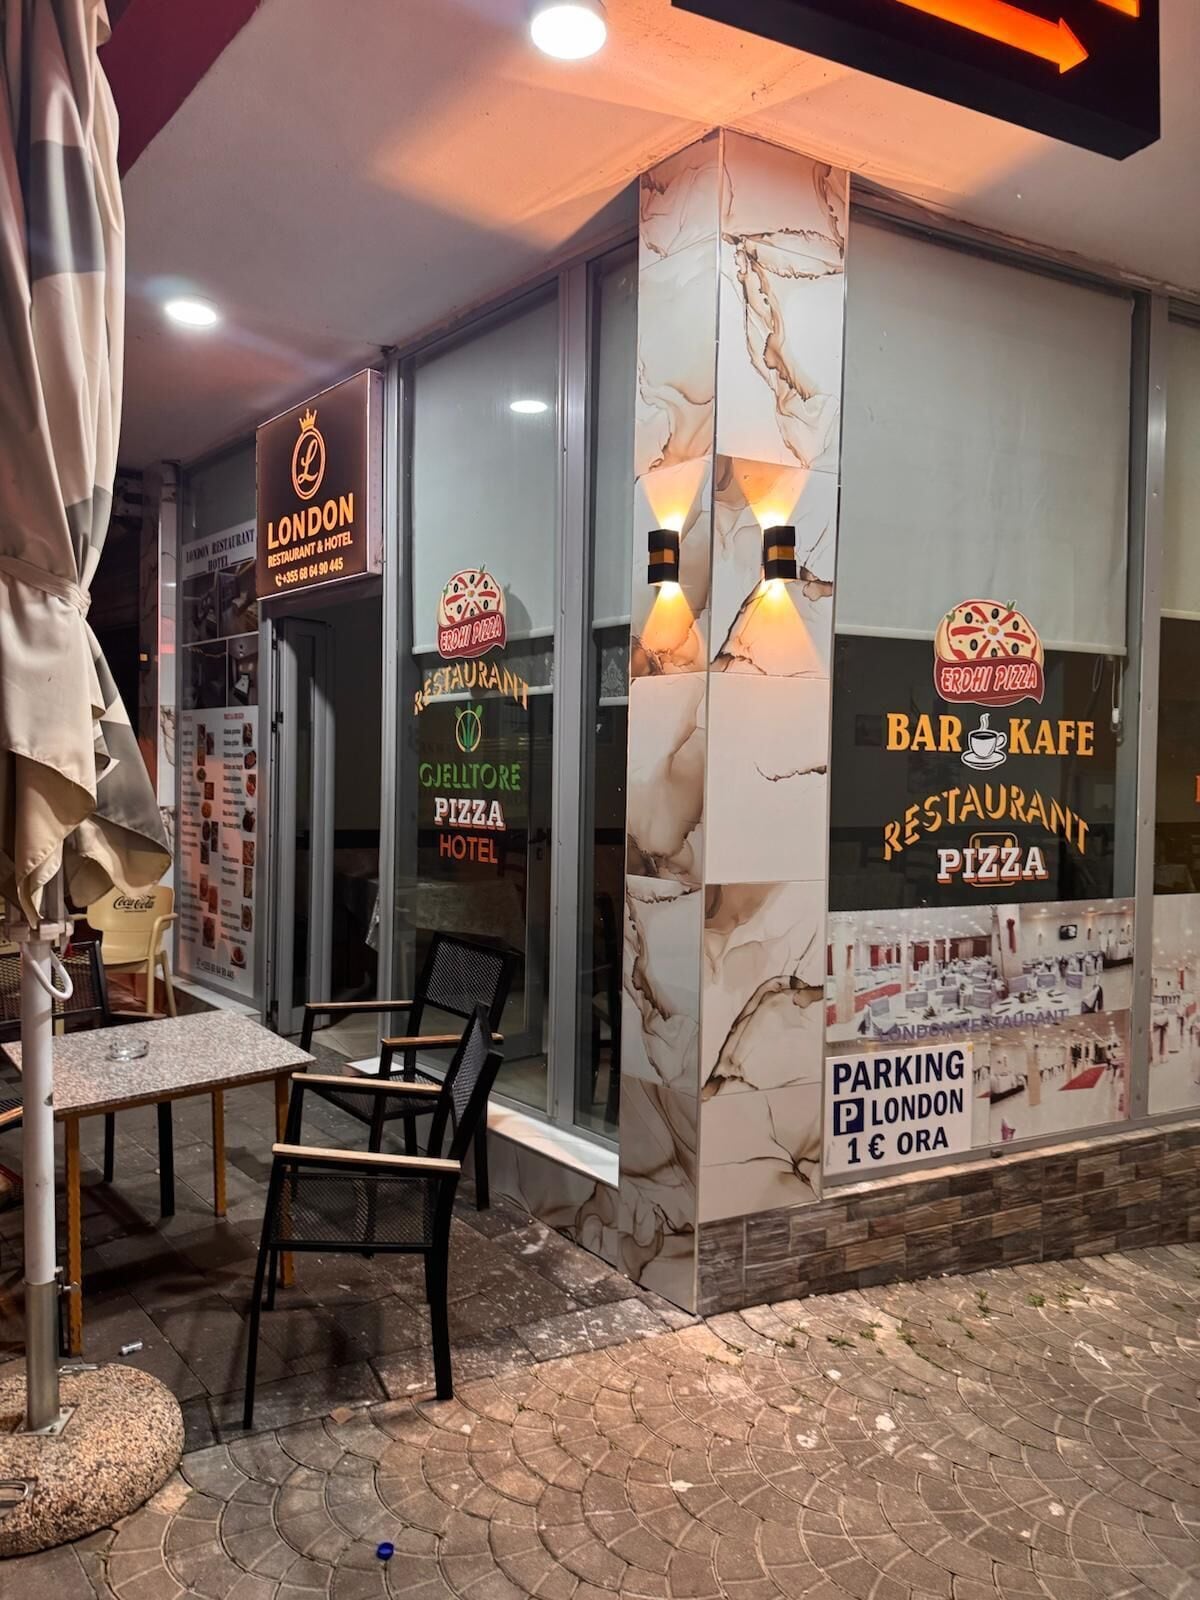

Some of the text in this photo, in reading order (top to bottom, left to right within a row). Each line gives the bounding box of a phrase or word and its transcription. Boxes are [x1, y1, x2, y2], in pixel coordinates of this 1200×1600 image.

[267, 493, 354, 550] LONDON
[186, 529, 255, 564] LONDON RESTAURANT
[207, 555, 229, 572] HOTEL
[267, 531, 353, 569] RESTAURANT & HOTEL
[309, 563, 318, 578] 64
[318, 560, 329, 576] 90
[329, 556, 344, 573] 445
[471, 614, 503, 645] PIZZA
[413, 661, 529, 716] RESTAURANT
[941, 663, 1038, 694] ERDHI PIZZA
[886, 712, 1095, 756] BAR KAFE
[419, 762, 521, 791] GJELLTORE
[434, 797, 506, 831] PIZZA
[882, 783, 1090, 861] RESTAURANT
[439, 833, 498, 864] HOTEL
[936, 846, 1049, 884] PIZZA
[879, 1008, 1069, 1043] LONDON RESTAURANT
[833, 1050, 965, 1095] PARKING
[837, 1088, 964, 1135] P LONDON
[847, 1127, 949, 1165] 1 € ORA
